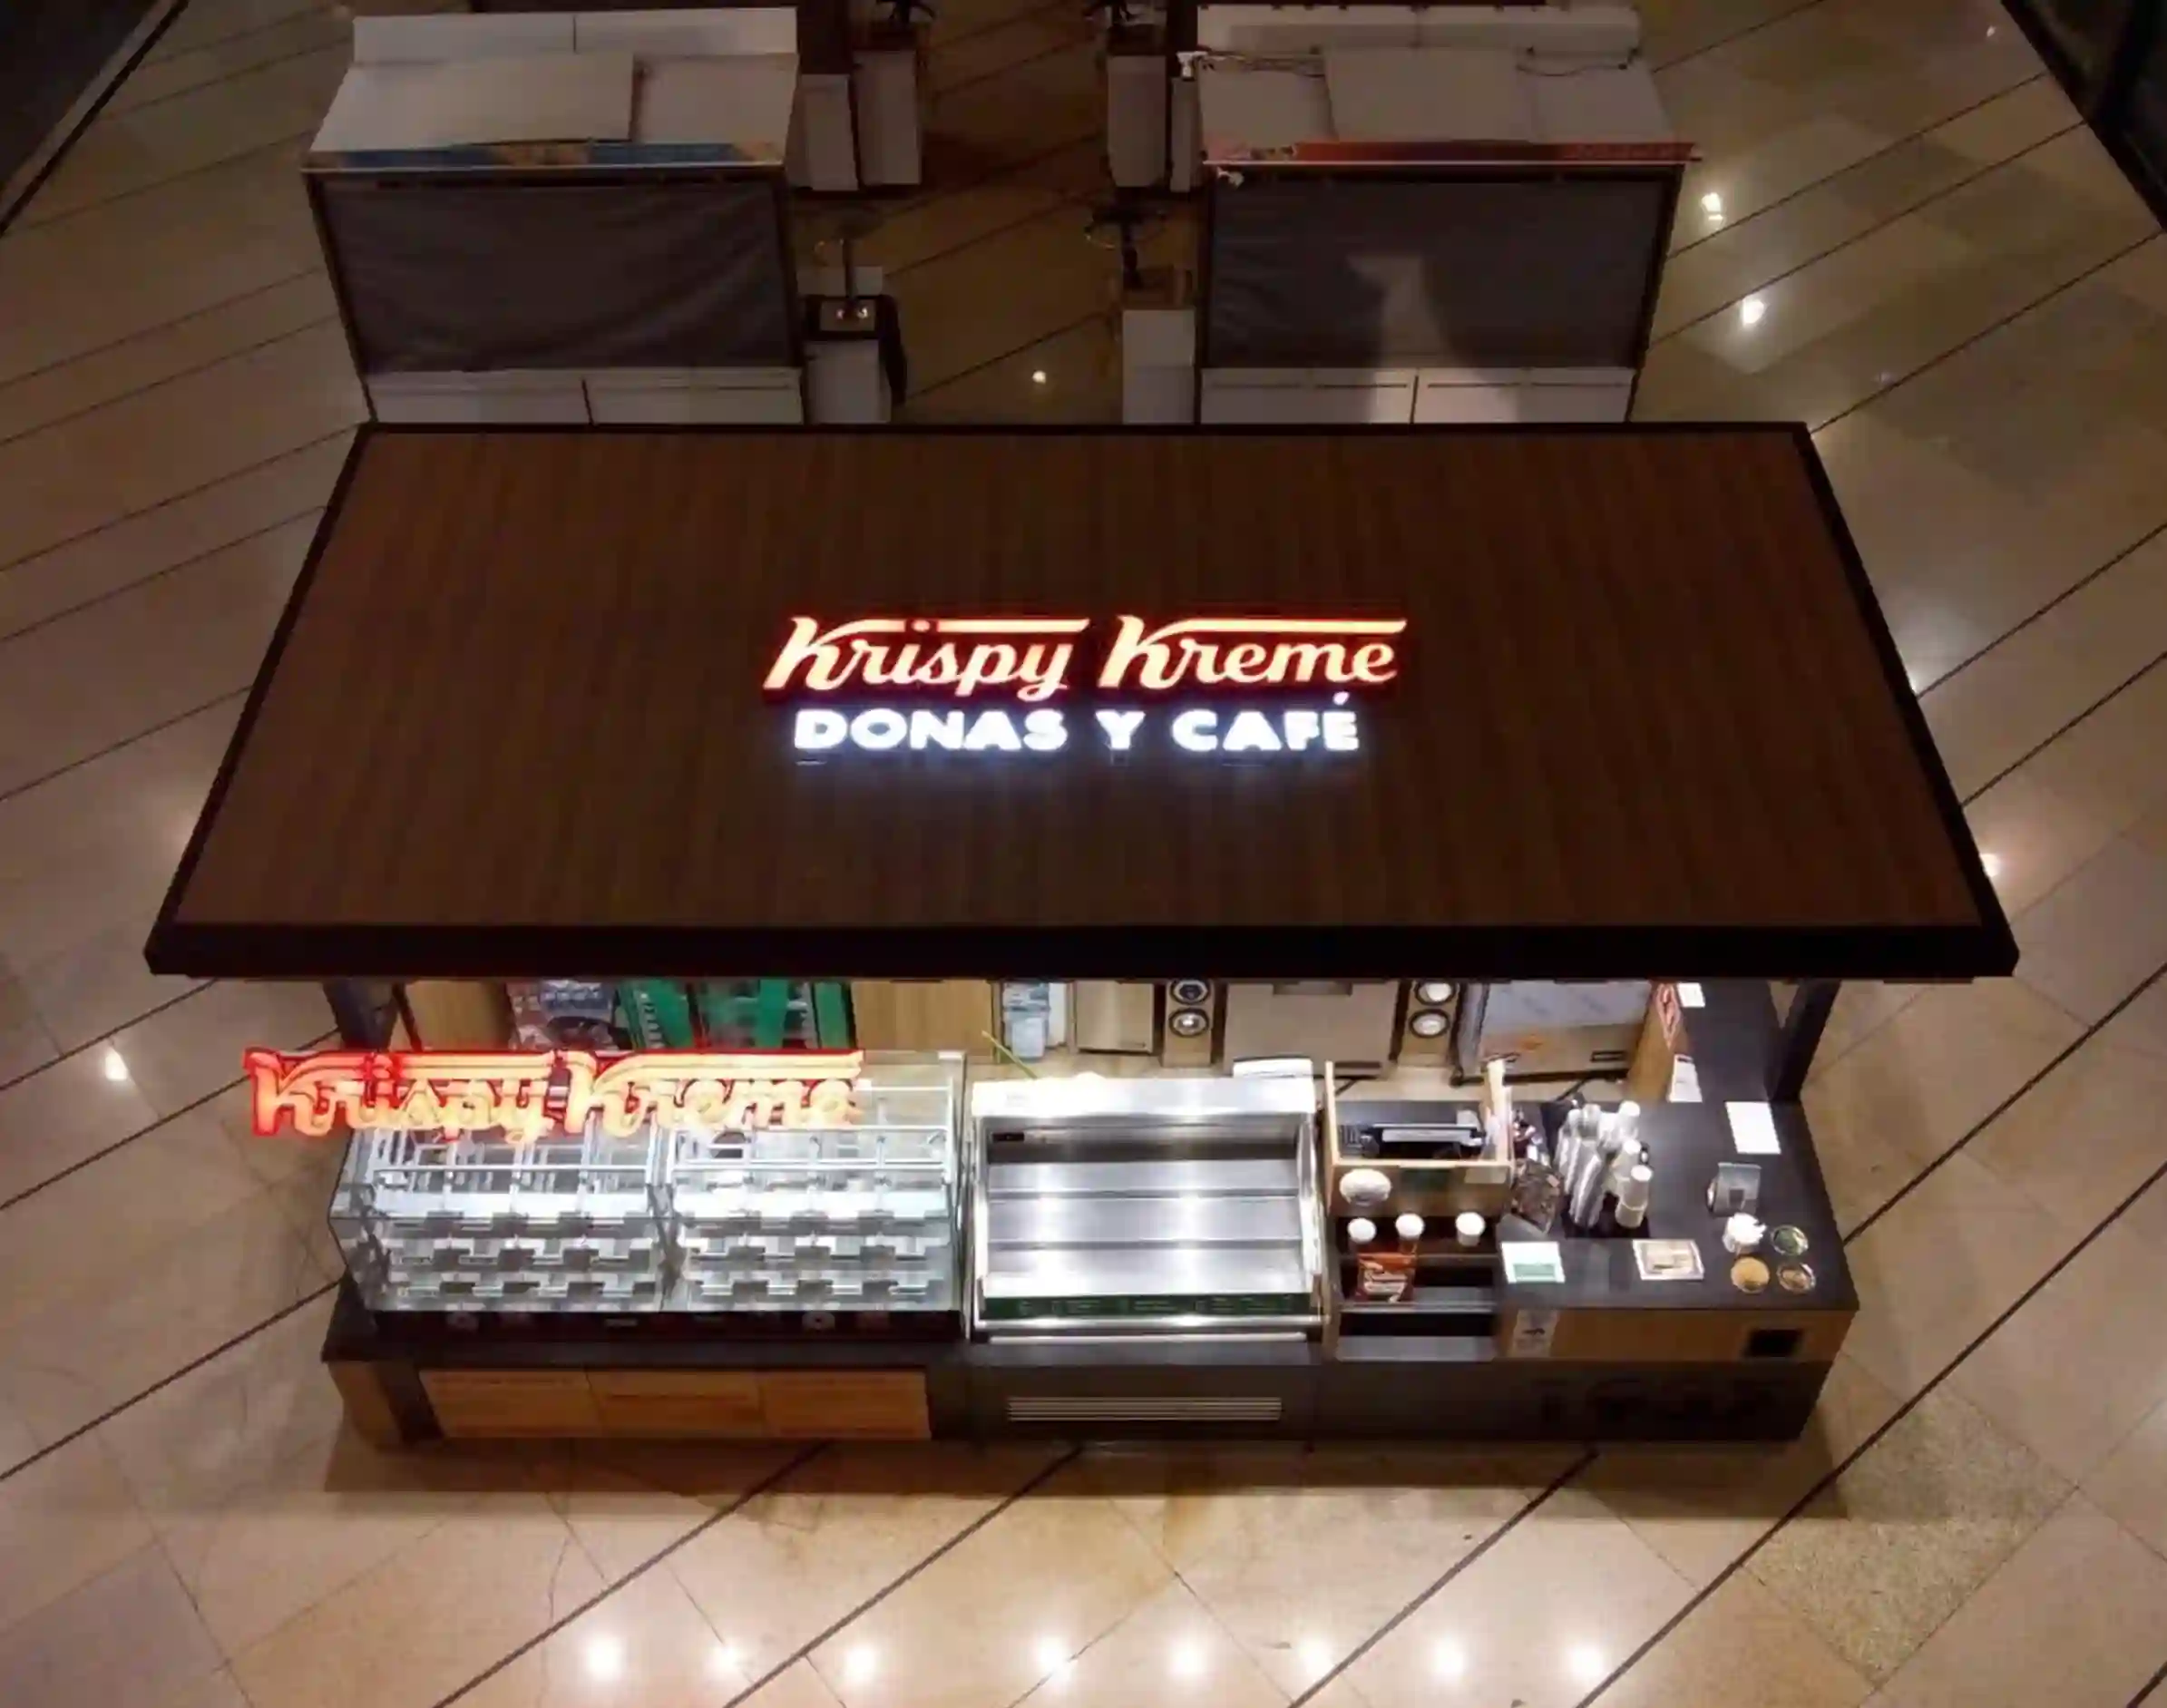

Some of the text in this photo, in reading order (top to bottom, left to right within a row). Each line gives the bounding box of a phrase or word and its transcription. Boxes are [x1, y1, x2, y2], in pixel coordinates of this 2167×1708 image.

[763, 615, 1407, 702] Krispy Kreme
[795, 691, 1360, 751] DONAS Y CAFÉ
[243, 1049, 864, 1144] Krispy Kreme
